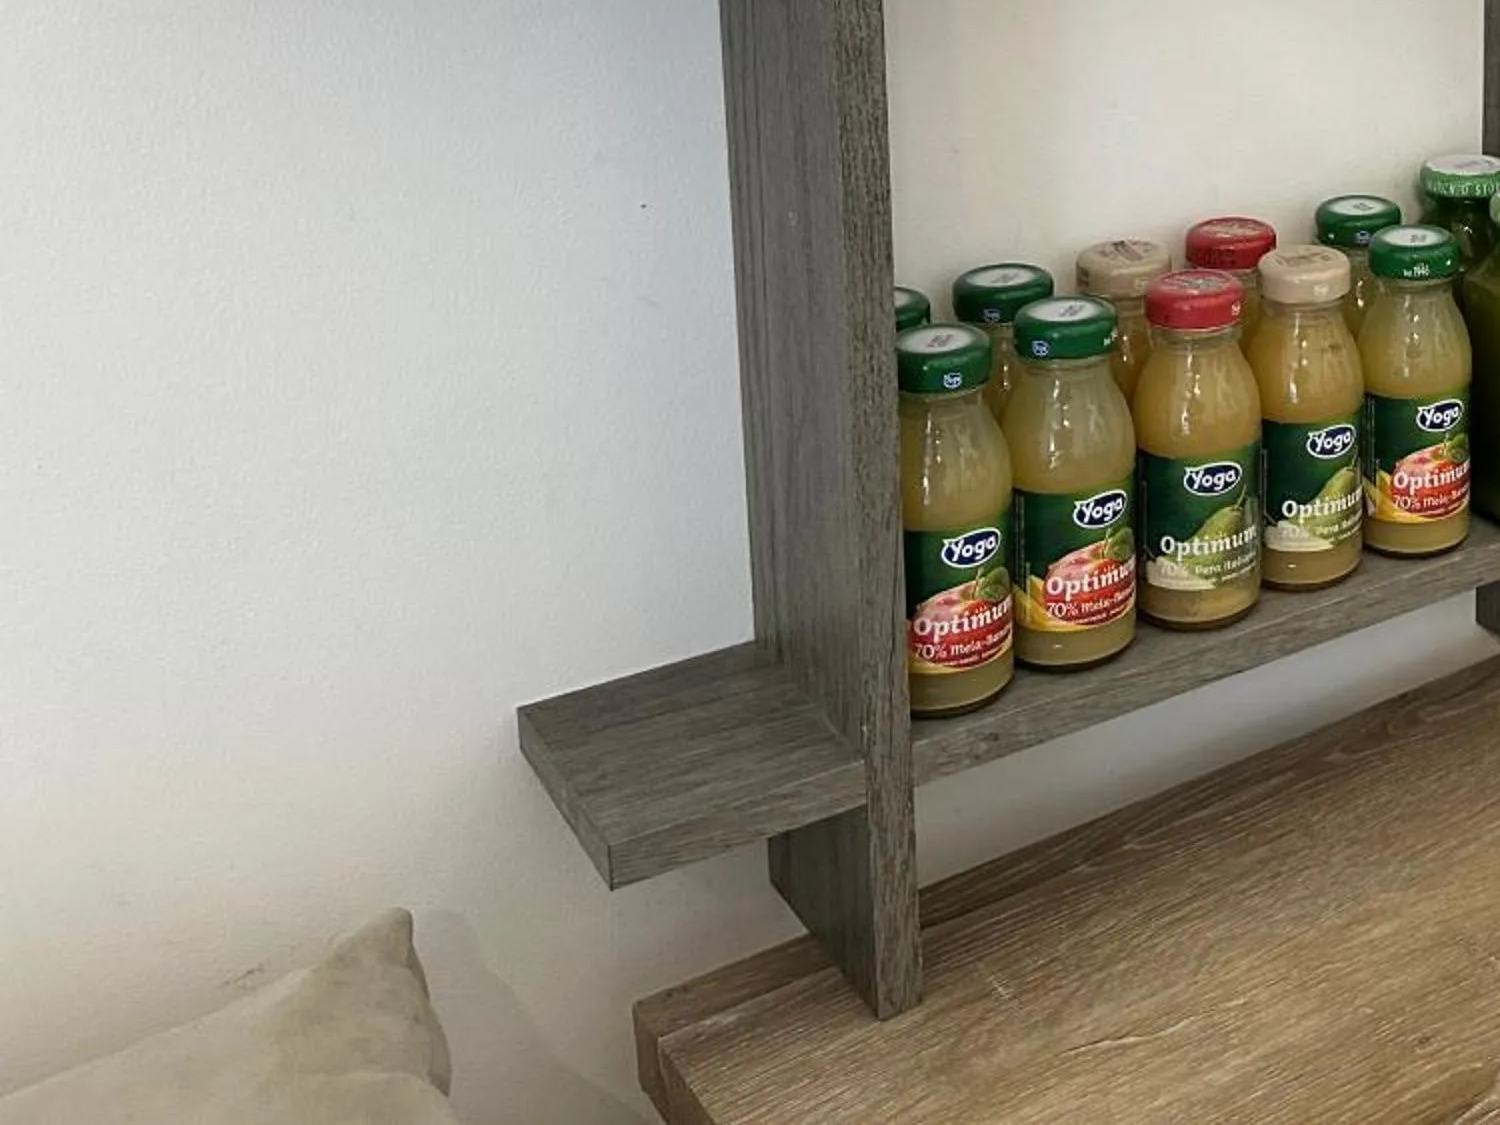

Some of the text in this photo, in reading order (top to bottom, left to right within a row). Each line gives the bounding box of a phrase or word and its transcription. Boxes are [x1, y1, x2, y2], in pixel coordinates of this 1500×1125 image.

[1424, 405, 1459, 426] Yoga
[1315, 431, 1351, 452] Yoga
[1192, 469, 1237, 491] Yoga
[1083, 496, 1123, 523] Yoga
[951, 535, 996, 562] Yoga
[1160, 525, 1257, 562] Optimum
